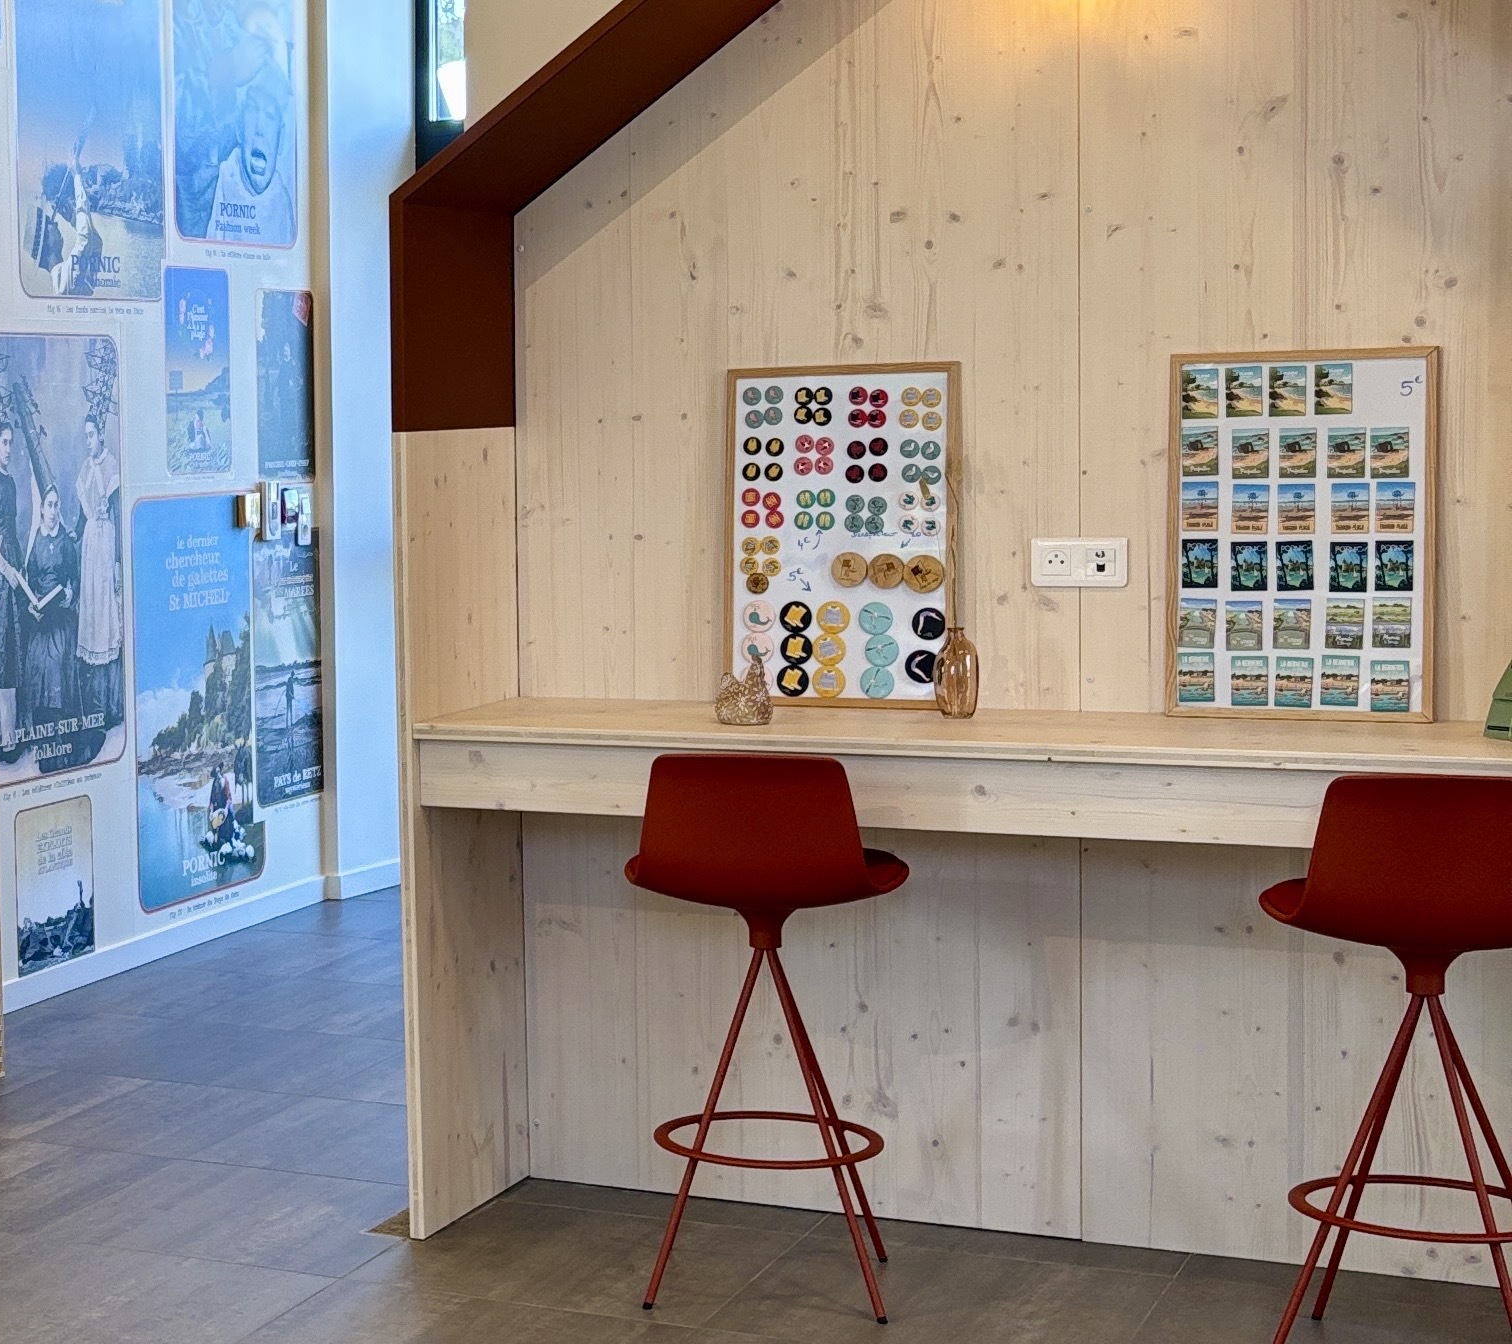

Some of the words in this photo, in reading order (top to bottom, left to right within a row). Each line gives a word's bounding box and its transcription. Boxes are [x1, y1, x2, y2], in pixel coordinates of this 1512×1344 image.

[219, 202, 256, 219] PORNIC
[177, 536, 185, 549] le
[166, 549, 220, 569] chercheur
[172, 570, 185, 587] de
[188, 567, 228, 590] galettes
[169, 594, 180, 611] St
[183, 588, 228, 608] MICHEL
[15, 713, 105, 744] PLAINE-SUR-MER
[34, 742, 73, 760] folklore
[182, 850, 225, 876] PORNIC
